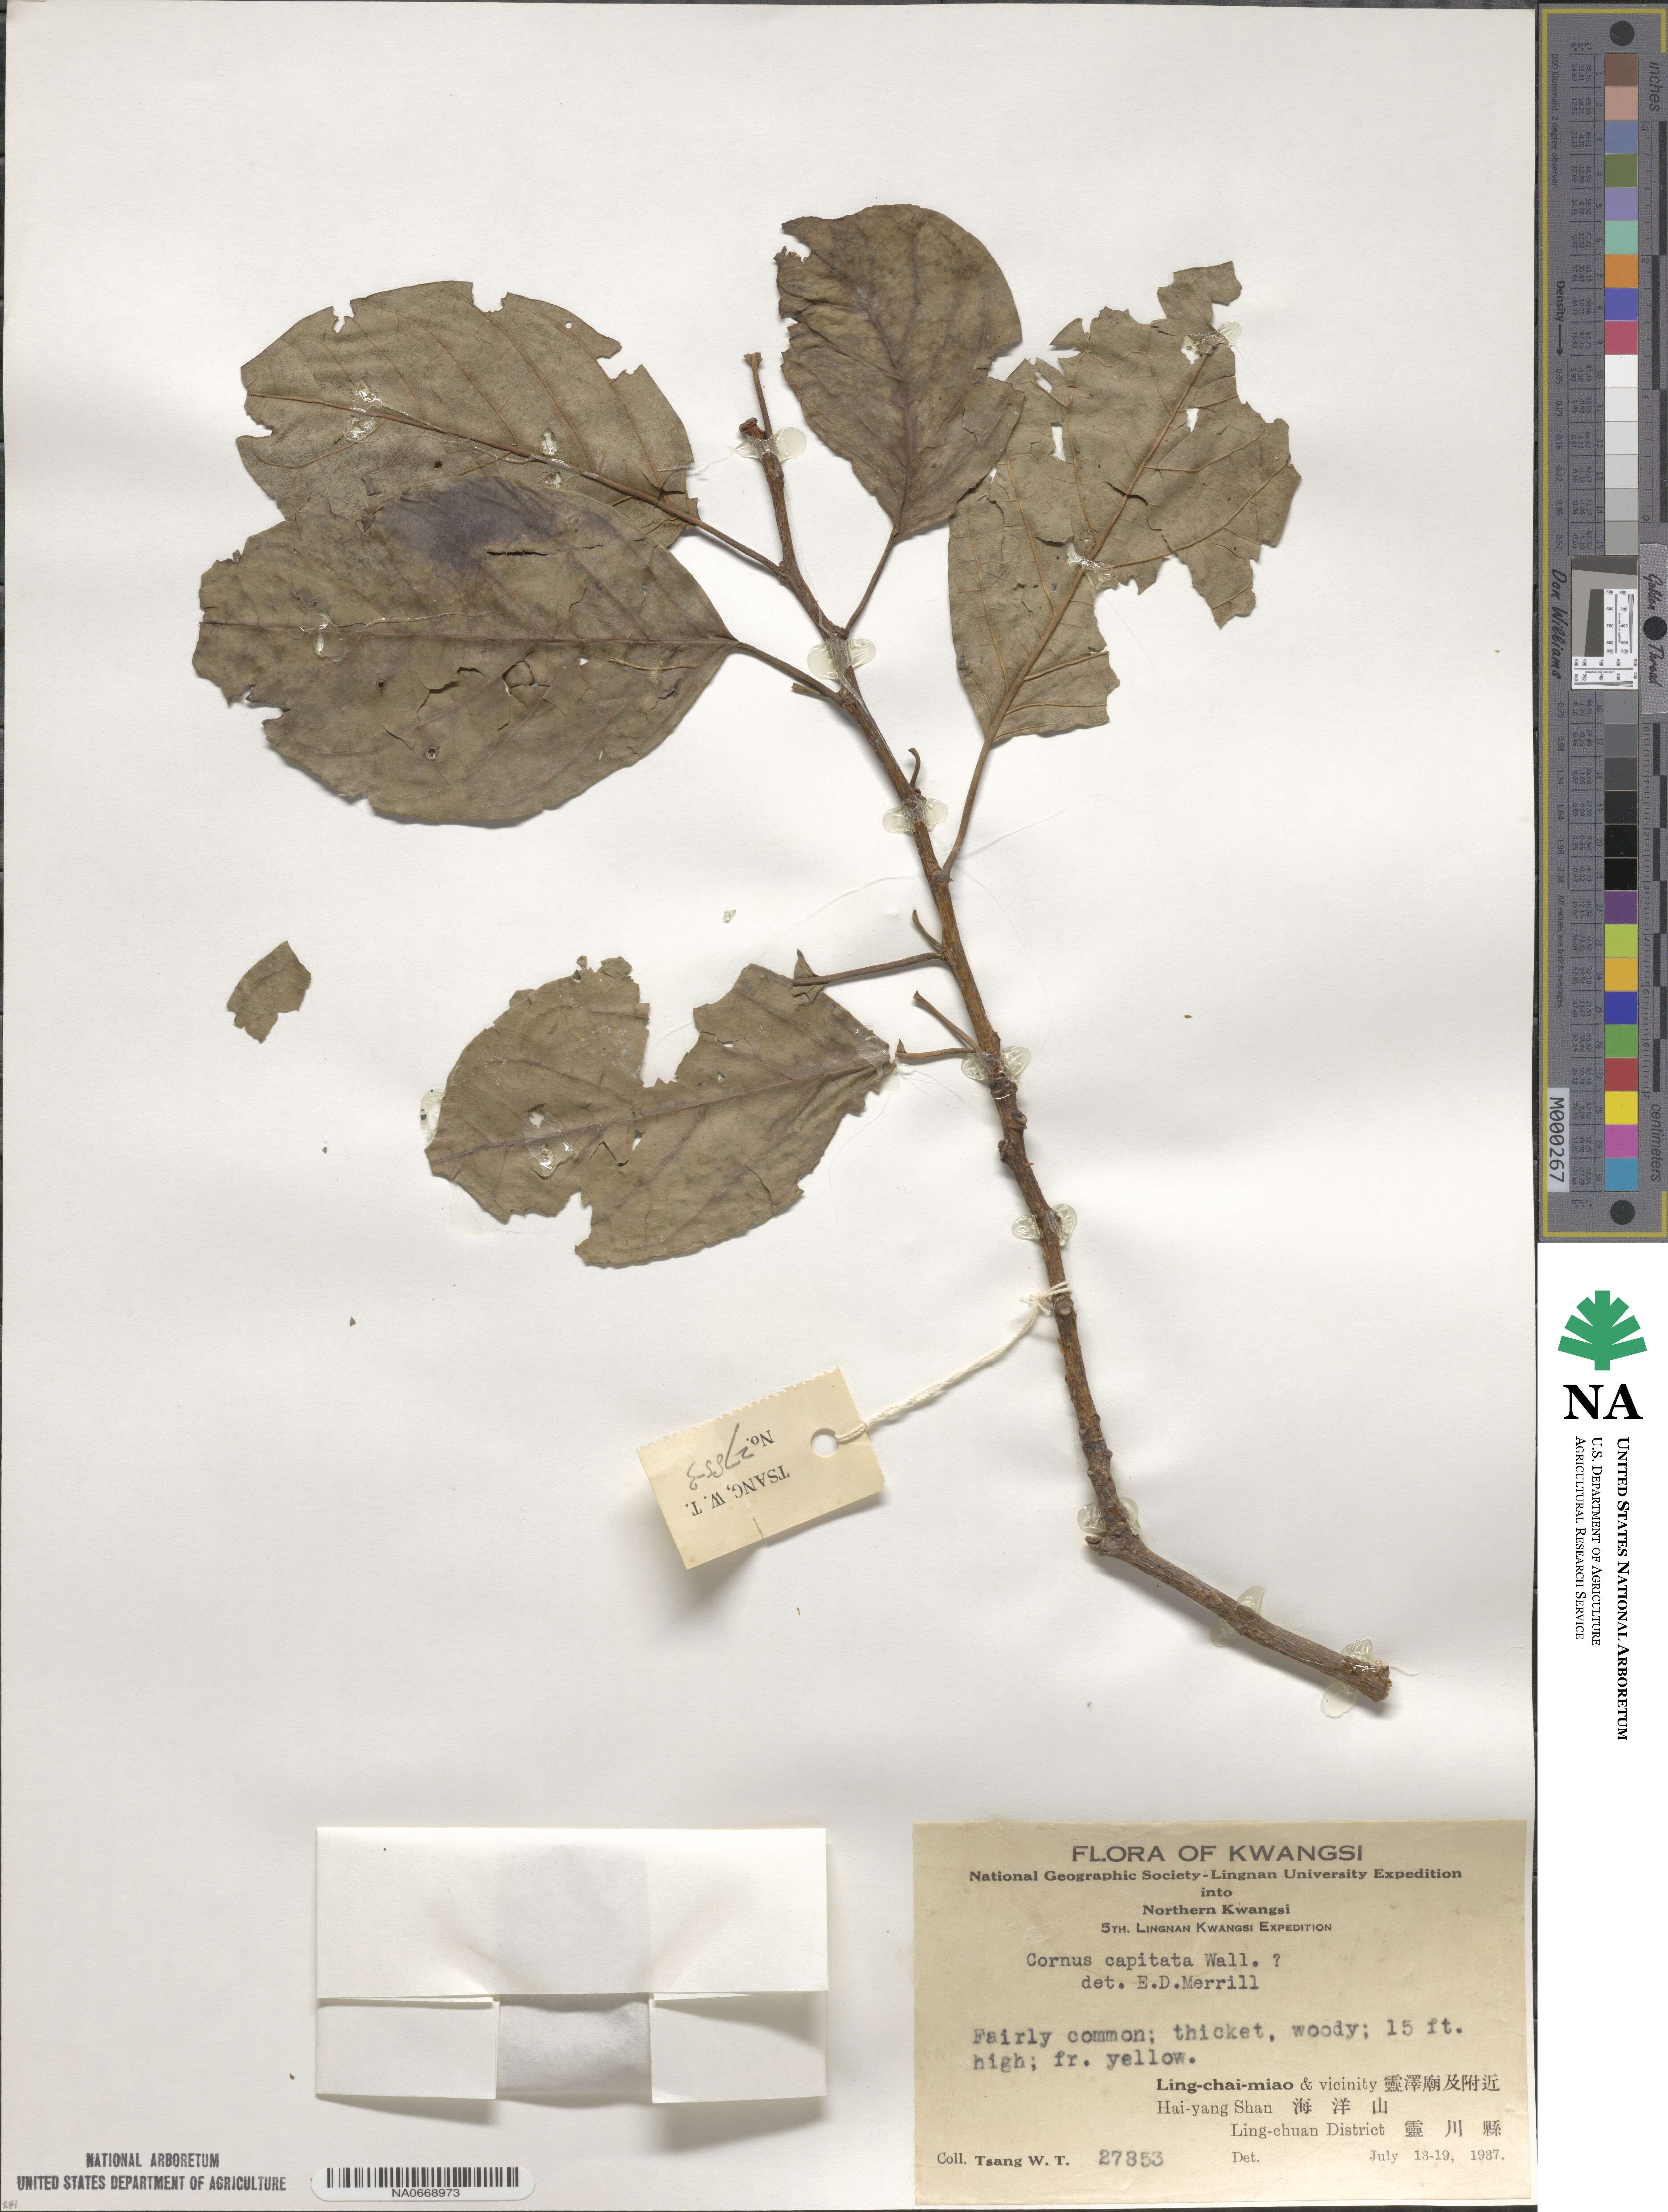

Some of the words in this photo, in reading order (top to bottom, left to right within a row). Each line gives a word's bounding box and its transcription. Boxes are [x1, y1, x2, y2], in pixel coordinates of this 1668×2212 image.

[1551, 71, 1559, 113] Illuminant,
[1649, 61, 1664, 112] inches
[1550, 123, 1559, 150] degree
[1555, 281, 1565, 322] Density
[1643, 574, 1664, 611] Golden
[1552, 606, 1568, 680] Williams
[1649, 645, 1664, 688] Thread
[1549, 1097, 1565, 1183] M000267
[1651, 1104, 1661, 1182] centimeters
[746, 1430, 775, 1447] No.
[726, 1465, 790, 1498] TSANG,
[685, 1501, 702, 1517] T.
[704, 1492, 726, 1509] W.
[1073, 1846, 1166, 1863] FLORA
[1179, 1845, 1217, 1862] OF
[1229, 1845, 1363, 1862] KWANGSI
[970, 1871, 1039, 1882] National
[1044, 1871, 1138, 1883] Geographic
[1284, 1869, 1368, 1880] University
[1374, 1868, 1463, 1880] Expedition
[1201, 1888, 1233, 1897] into
[1143, 1905, 1217, 1916] Northern
[1222, 1904, 1291, 1917] Kwangsi
[1101, 1923, 1130, 1934] 5TH.
[1137, 1923, 1191, 1934] LINGNAN
[1197, 1922, 1253, 1933] KWANGSI
[1260, 1922, 1332, 1932] EXPEDITION
[1027, 1953, 1093, 1968] Cornus
[1105, 1953, 1194, 1971] capitata
[1204, 1953, 1259, 1968] Wall.
[1273, 1953, 1281, 1968] ?
[1082, 1975, 1125, 1990] det.
[1137, 1975, 1260, 1991] E.D.Merrill
[973, 2027, 1053, 2048] Fairly
[1068, 2029, 1155, 2045] common;
[1173, 2023, 1276, 2043] thicket,
[1292, 2020, 1370, 2040] woody;
[1387, 2020, 1413, 2036] 15
[1428, 2018, 1463, 2035] ft.
[973, 2052, 1037, 2073] high;
[1054, 2050, 1090, 2068] fr.
[1107, 2048, 1196, 2071] yellow.
[1157, 2078, 1294, 2094] Ling-chai-miao
[1301, 2077, 1313, 2091] &
[1319, 2077, 1378, 2093] vicinity
[1157, 2101, 1229, 2115] Hai-yang
[1235, 2100, 1273, 2114] Shan
[1231, 2123, 1319, 2139] Ling-chuan
[1326, 2122, 1385, 2137] District
[86, 2153, 143, 2168] NATIONAL
[151, 2153, 220, 2168] ARBORETUM
[937, 2152, 967, 2166] Coll.
[975, 2156, 1023, 2168] Tsang
[1028, 2156, 1049, 2167] W.
[1055, 2156, 1070, 2167] T.
[1098, 2150, 1164, 2168] 27853
[1232, 2152, 1260, 2163] Det.
[1370, 2151, 1399, 2164] July
[1415, 2150, 1455, 2164] 13-19,
[1471, 2150, 1505, 2161] 1937.
[17, 2175, 60, 2191] UNITED
[64, 2175, 106, 2191] STATES
[111, 2175, 185, 2191] DEPARTMENT
[190, 2176, 205, 2191] OF
[209, 2176, 286, 2192] AGRICULTURE
[392, 2189, 461, 2198] NA0668973
